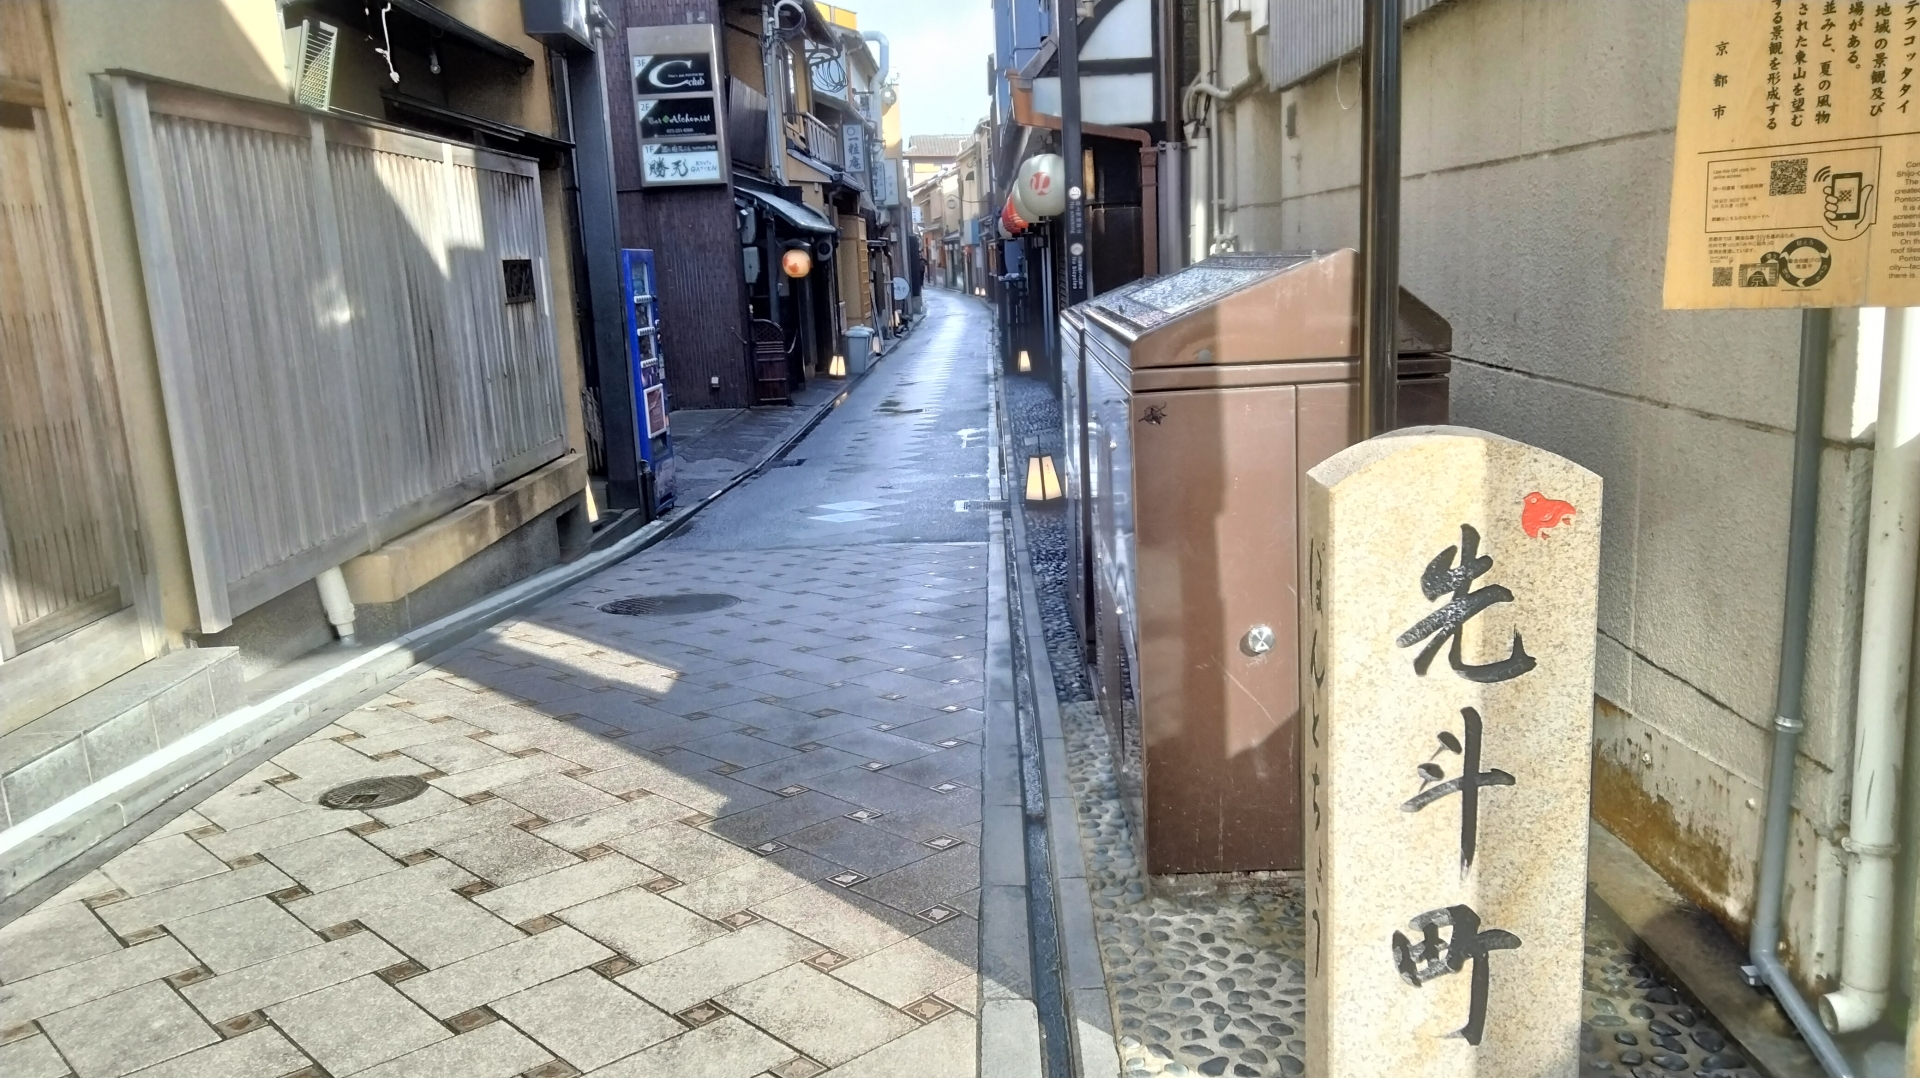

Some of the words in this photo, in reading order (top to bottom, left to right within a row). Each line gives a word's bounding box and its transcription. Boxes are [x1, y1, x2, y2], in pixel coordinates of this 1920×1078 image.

[1847, 0, 1864, 70] 場がある。
[637, 59, 646, 67] 3F
[1869, 2, 1892, 117] 地域の景観及び
[1712, 40, 1730, 120] 京都市
[640, 104, 650, 112] 2F
[669, 114, 711, 124] Alchemist
[646, 146, 654, 154] 1F
[690, 164, 717, 172] GATTEN
[1070, 201, 1075, 210] No
[1072, 256, 1077, 265] No
[1391, 523, 1537, 1046] 先斗町
